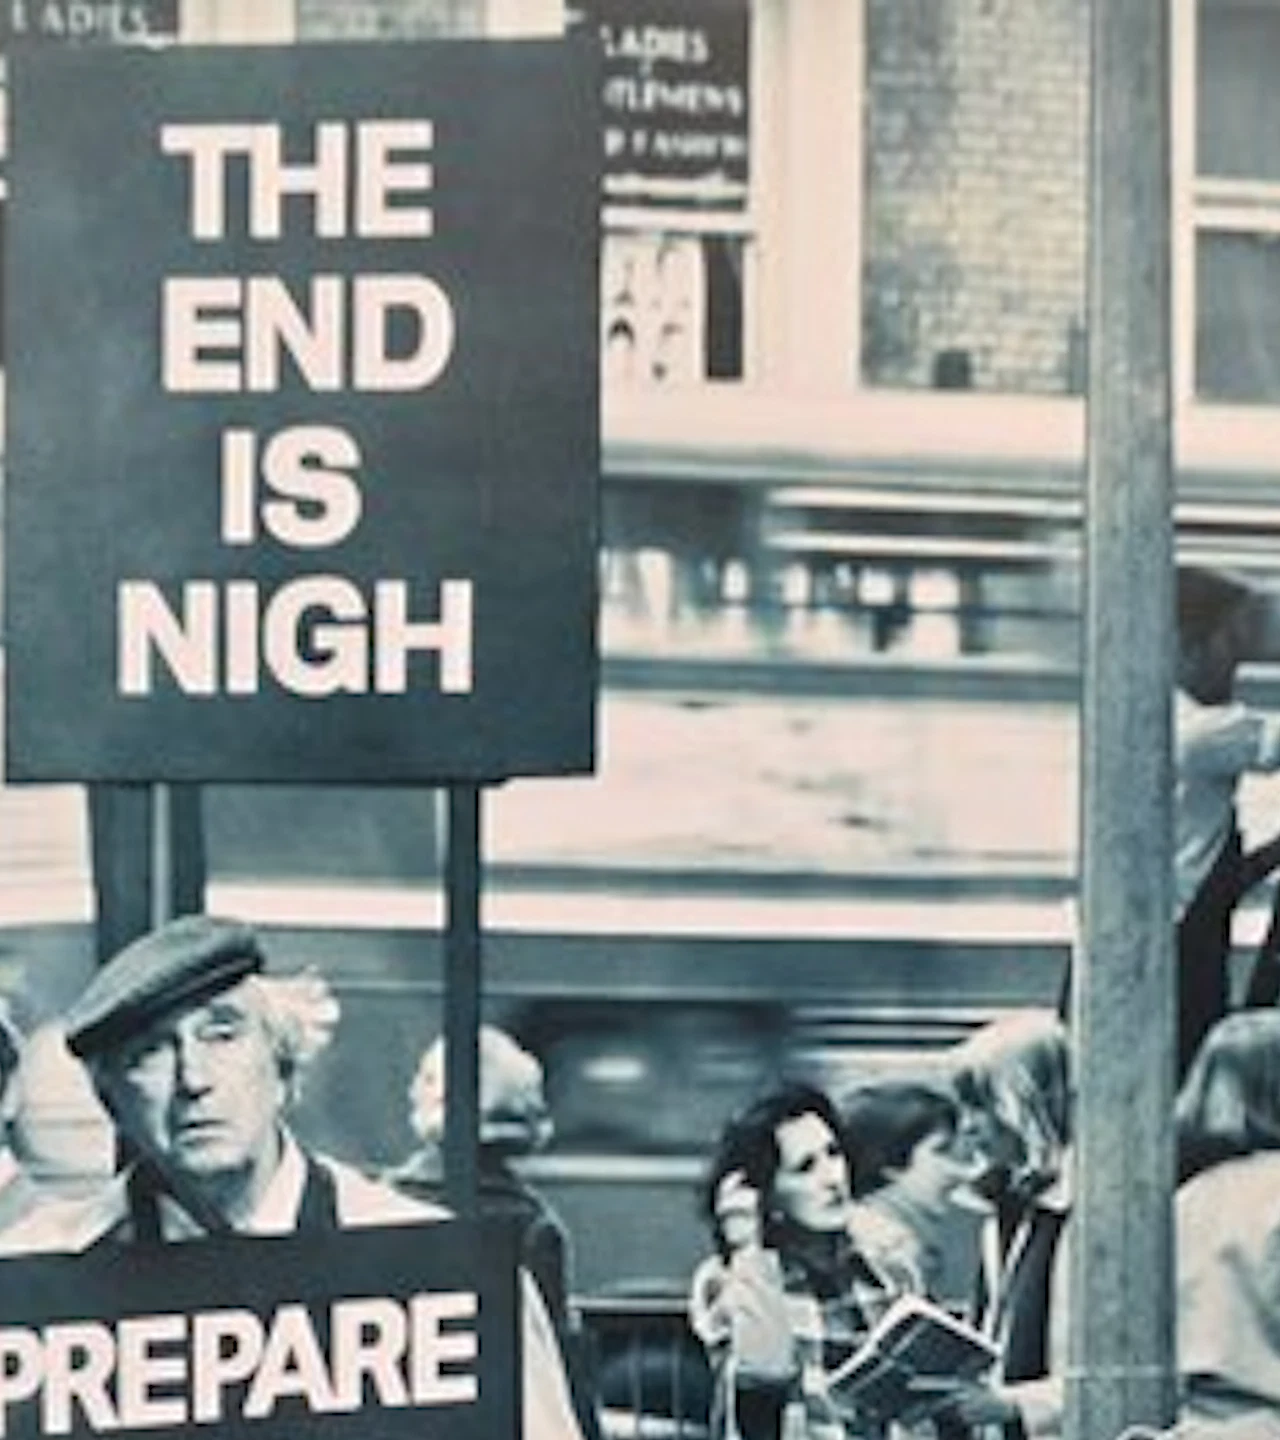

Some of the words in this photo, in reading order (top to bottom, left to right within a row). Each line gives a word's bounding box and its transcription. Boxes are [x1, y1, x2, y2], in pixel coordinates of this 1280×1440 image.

[160, 119, 434, 241] THE
[162, 273, 455, 393] END
[222, 425, 362, 547] IS
[118, 575, 473, 695] NIGH
